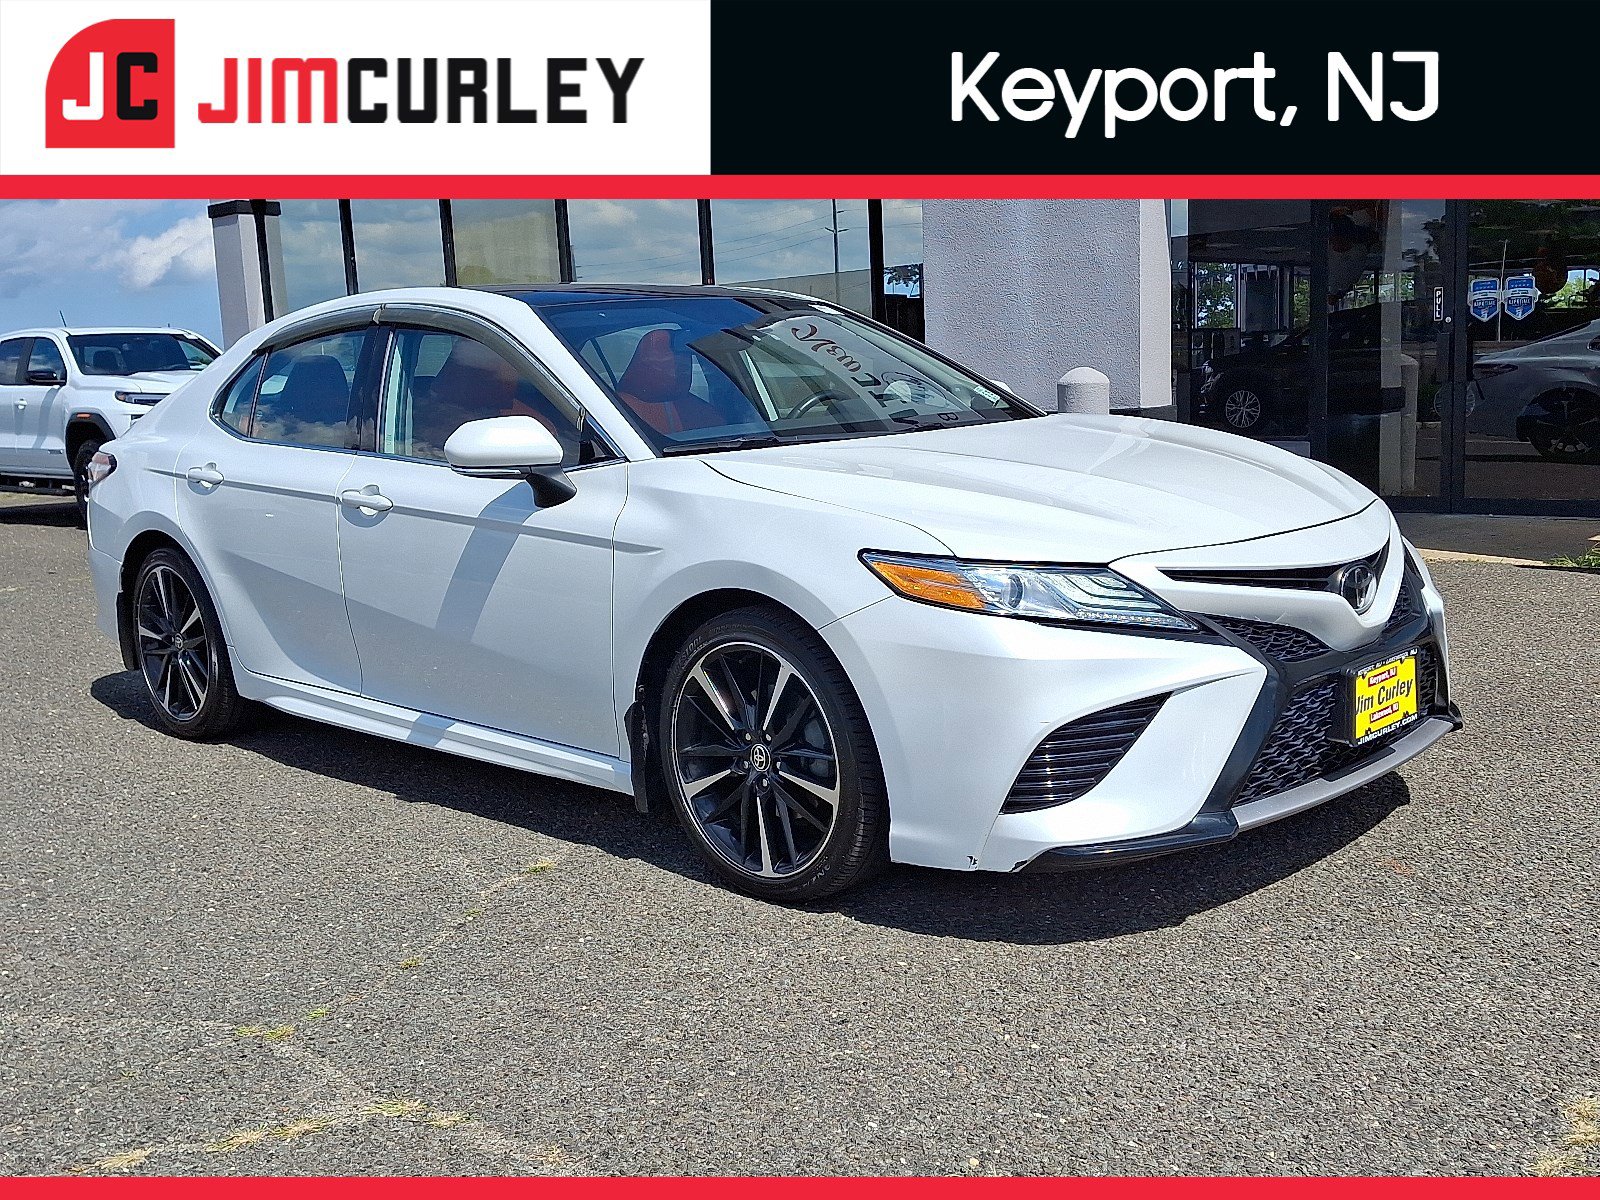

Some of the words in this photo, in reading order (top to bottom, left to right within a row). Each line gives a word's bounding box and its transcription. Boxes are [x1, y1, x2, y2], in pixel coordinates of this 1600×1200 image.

[1355, 695, 1374, 715] Jim
[1378, 679, 1413, 705] Curley
[1357, 713, 1418, 745] JIMCURLEY.COM
